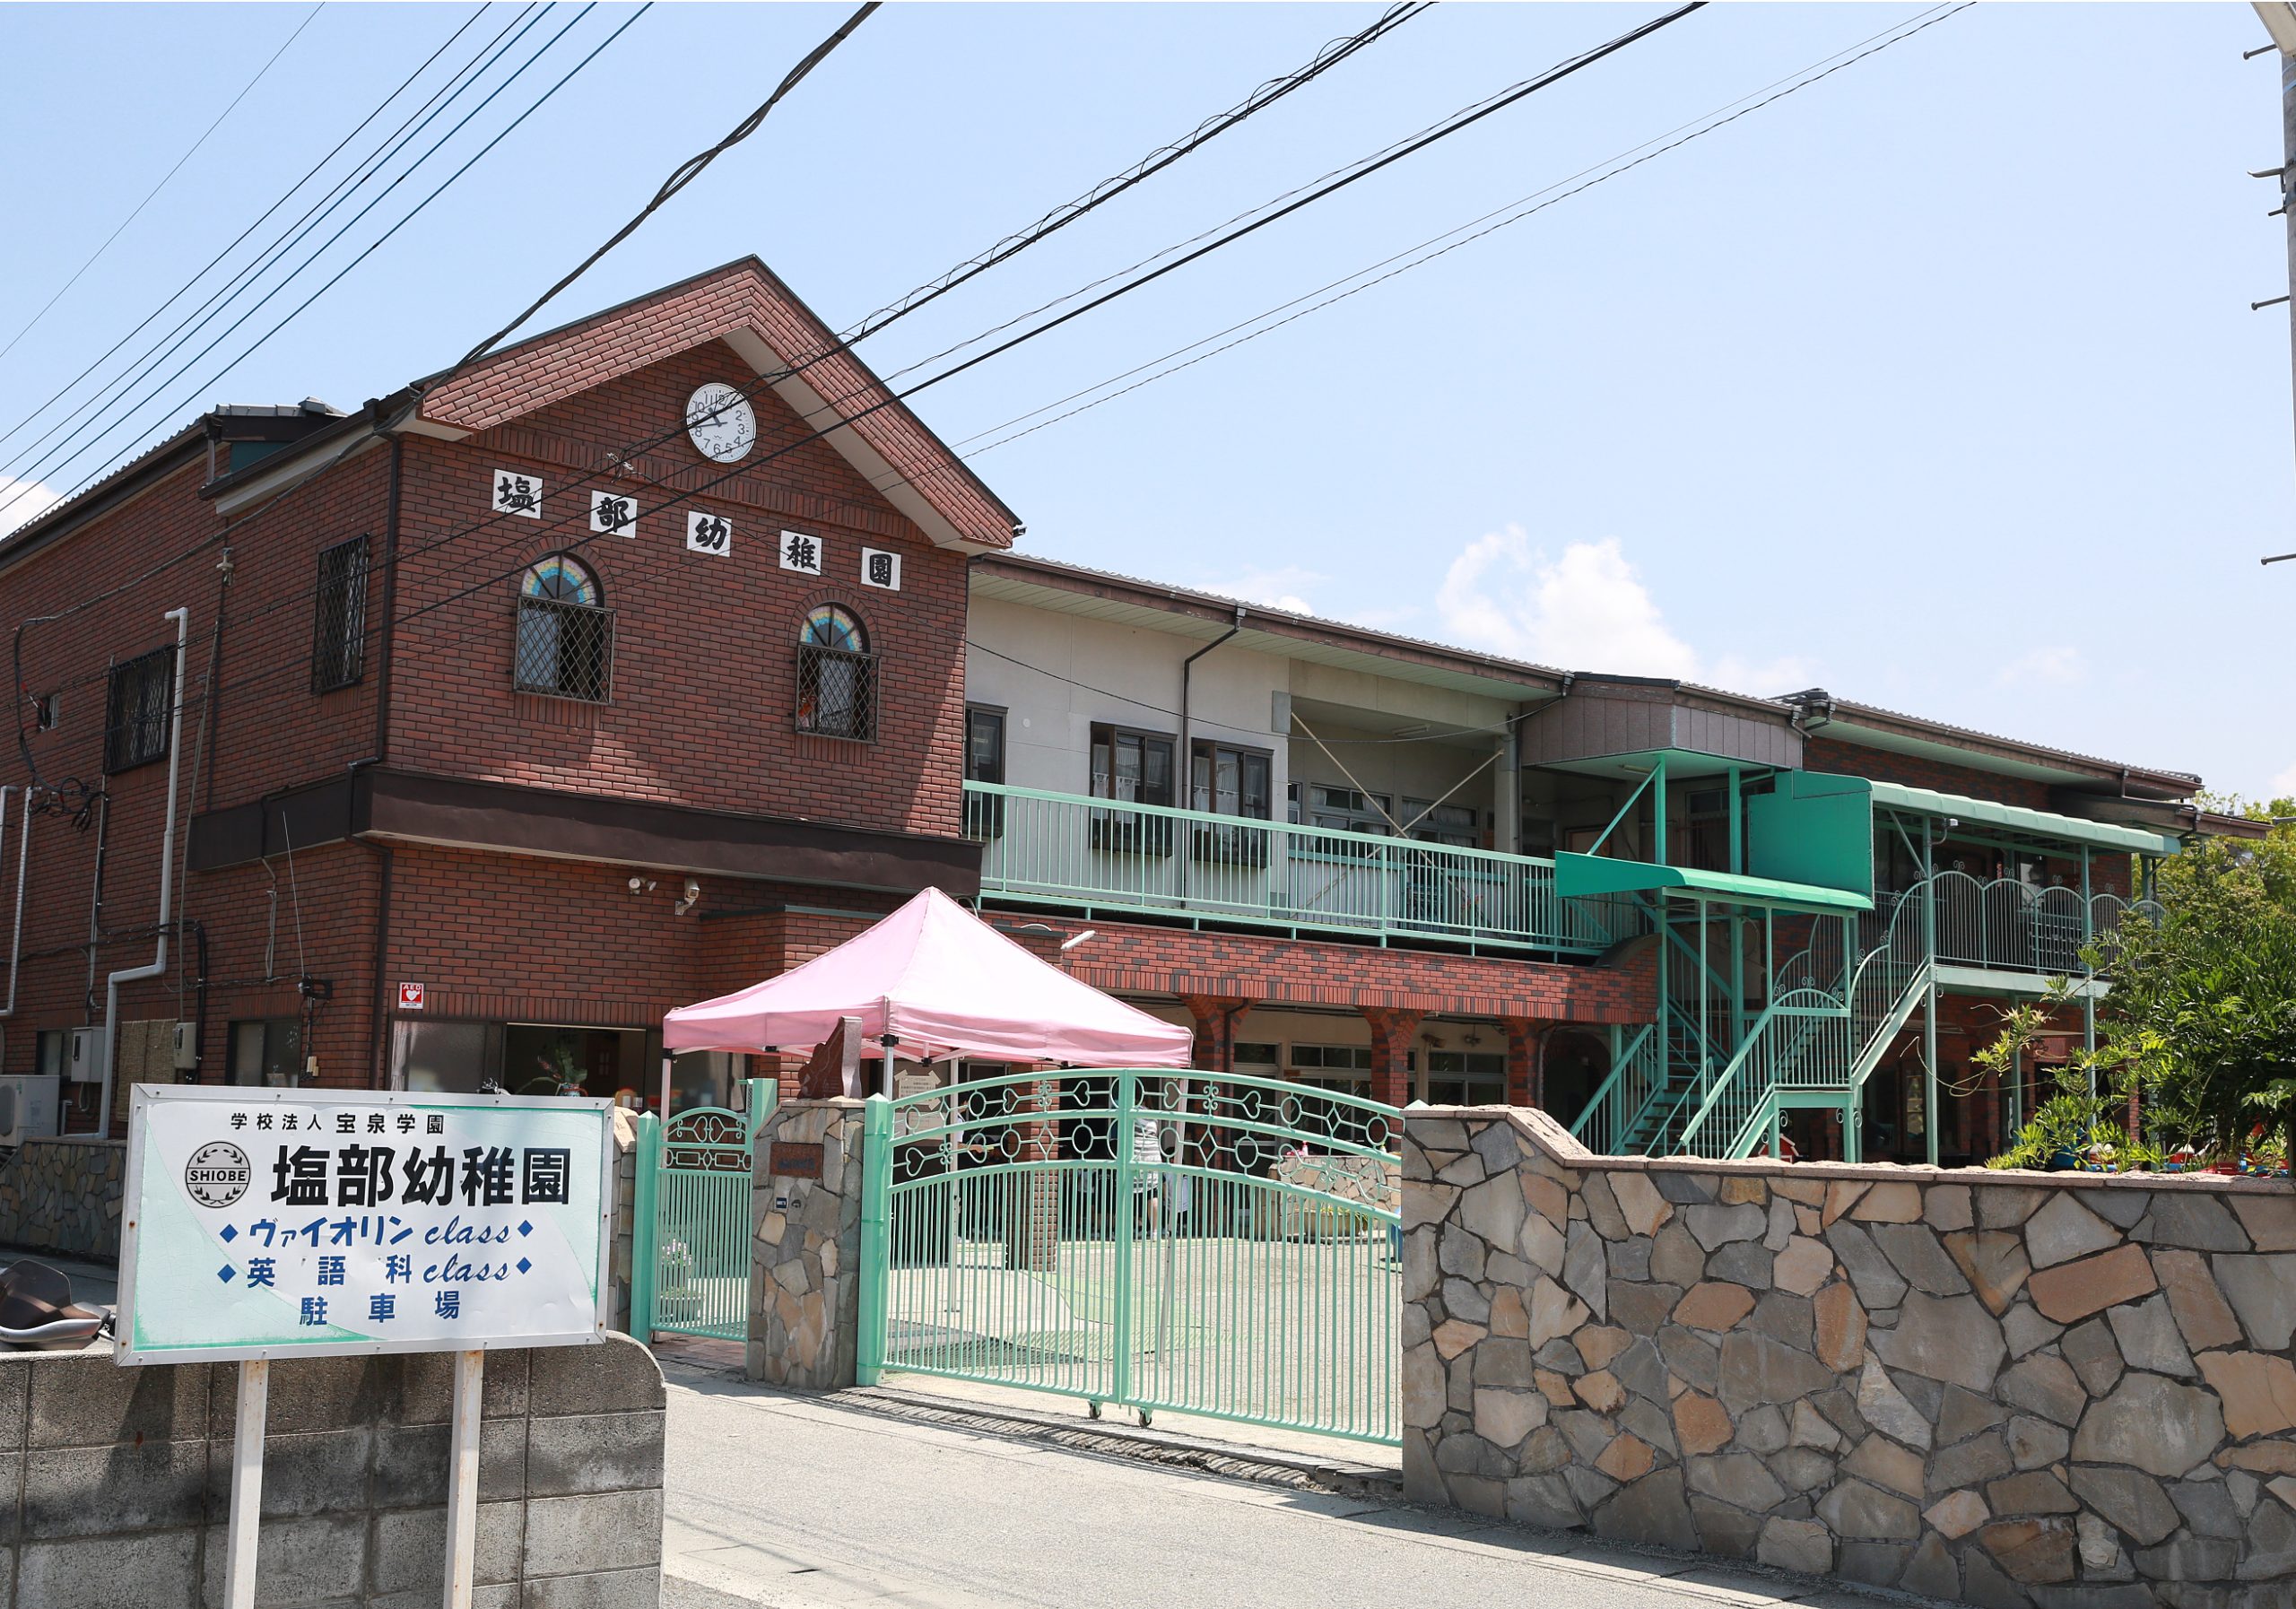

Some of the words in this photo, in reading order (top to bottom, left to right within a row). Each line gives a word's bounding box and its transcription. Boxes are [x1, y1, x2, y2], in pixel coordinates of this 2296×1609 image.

[695, 401, 705, 413] 10
[735, 410, 743, 422] 2
[694, 426, 702, 438] 8
[737, 423, 745, 434] 3
[703, 438, 710, 448] 7
[734, 436, 741, 447] 4
[713, 443, 721, 455] 6
[725, 442, 733, 454] 5
[189, 1170, 247, 1182] SHIOBE
[271, 1144, 570, 1207] 塩部幼稚園
[249, 1215, 413, 1248] ヴァイオリン
[424, 1214, 509, 1244] class
[422, 1252, 508, 1283] class
[300, 1291, 460, 1326] 駐車場
